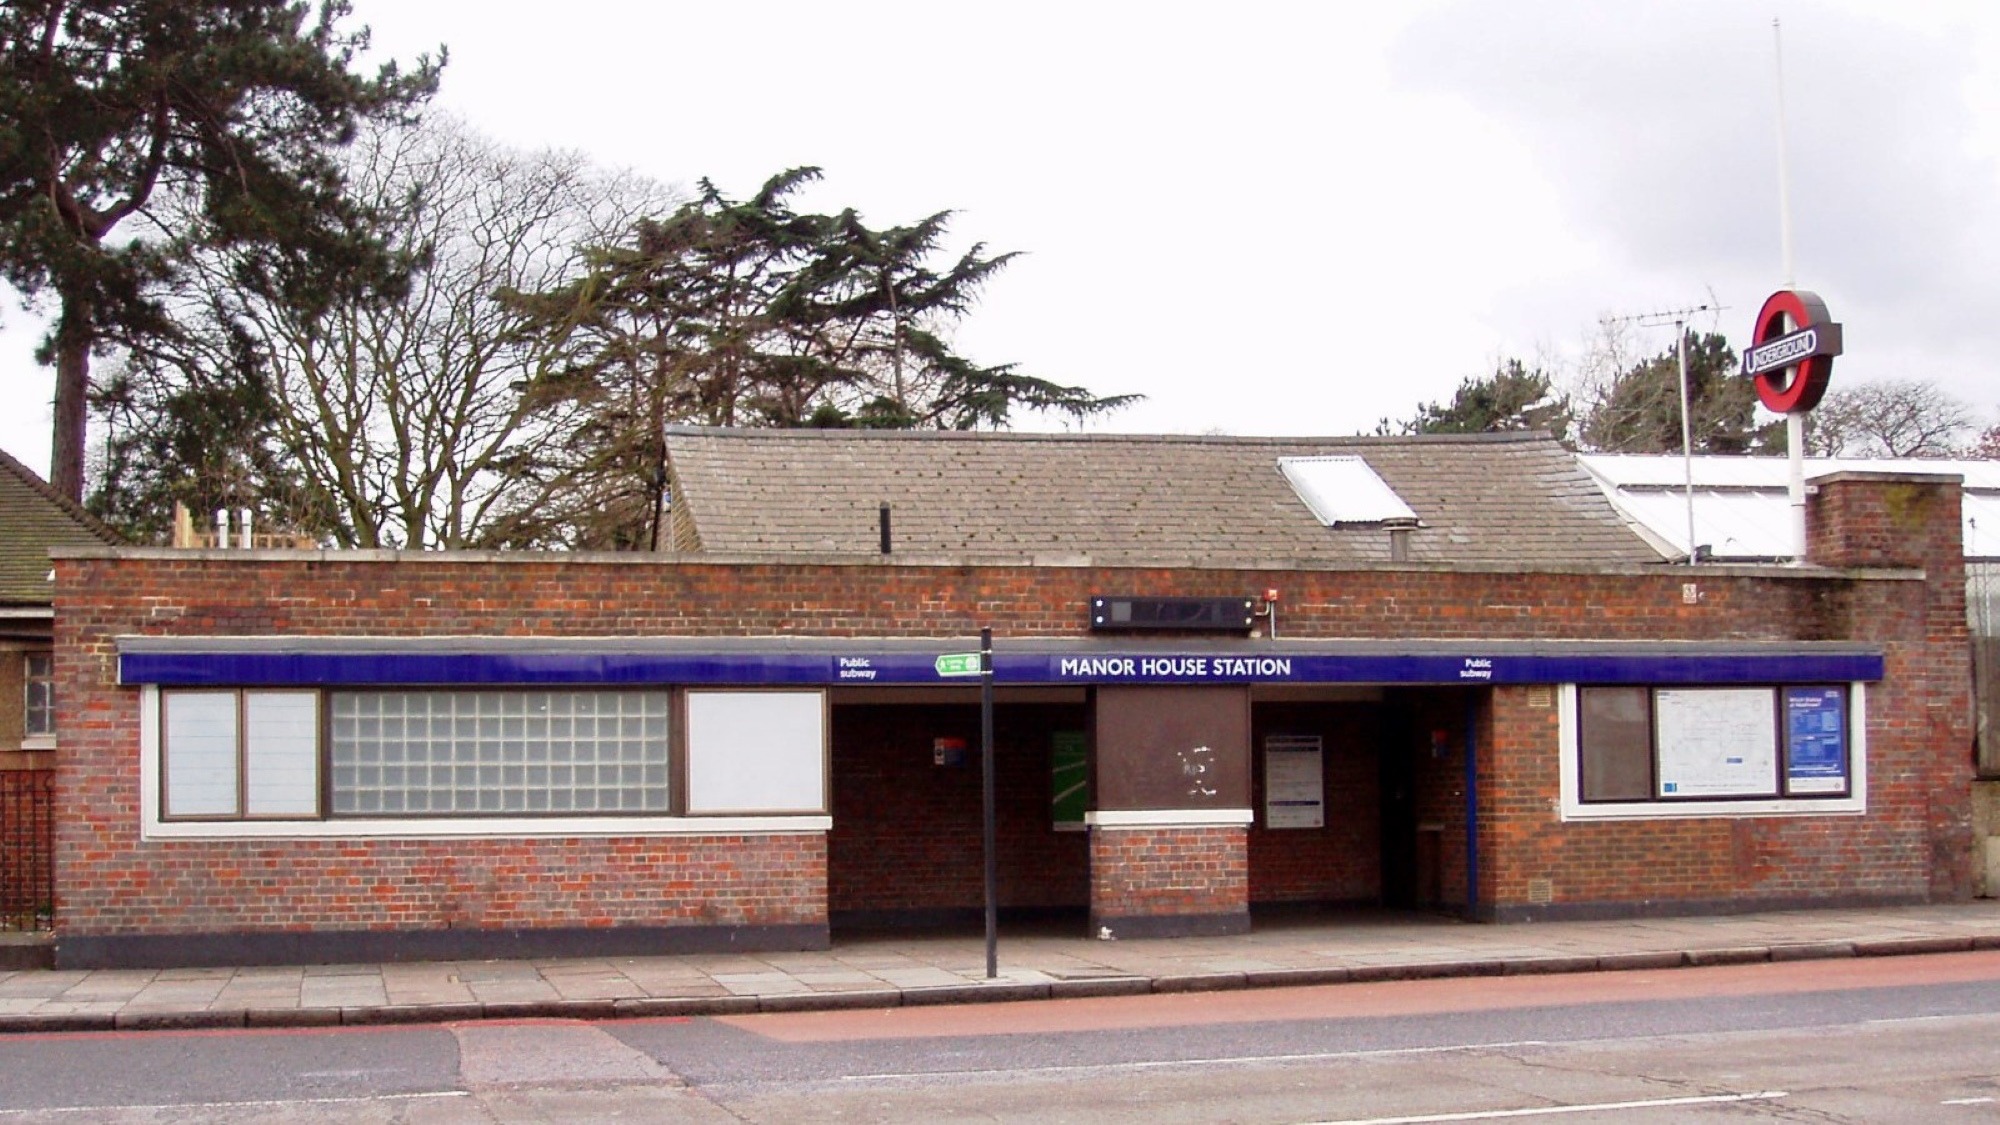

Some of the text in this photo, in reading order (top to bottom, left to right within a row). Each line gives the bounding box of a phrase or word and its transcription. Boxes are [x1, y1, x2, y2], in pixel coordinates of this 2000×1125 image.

[1746, 330, 1817, 374] UNDERGROUND
[840, 657, 871, 668] Public
[1060, 658, 1291, 676] MANOR HOUSE STATION
[1465, 658, 1492, 668] Public
[840, 668, 877, 680] subway
[1460, 669, 1492, 680] subway
